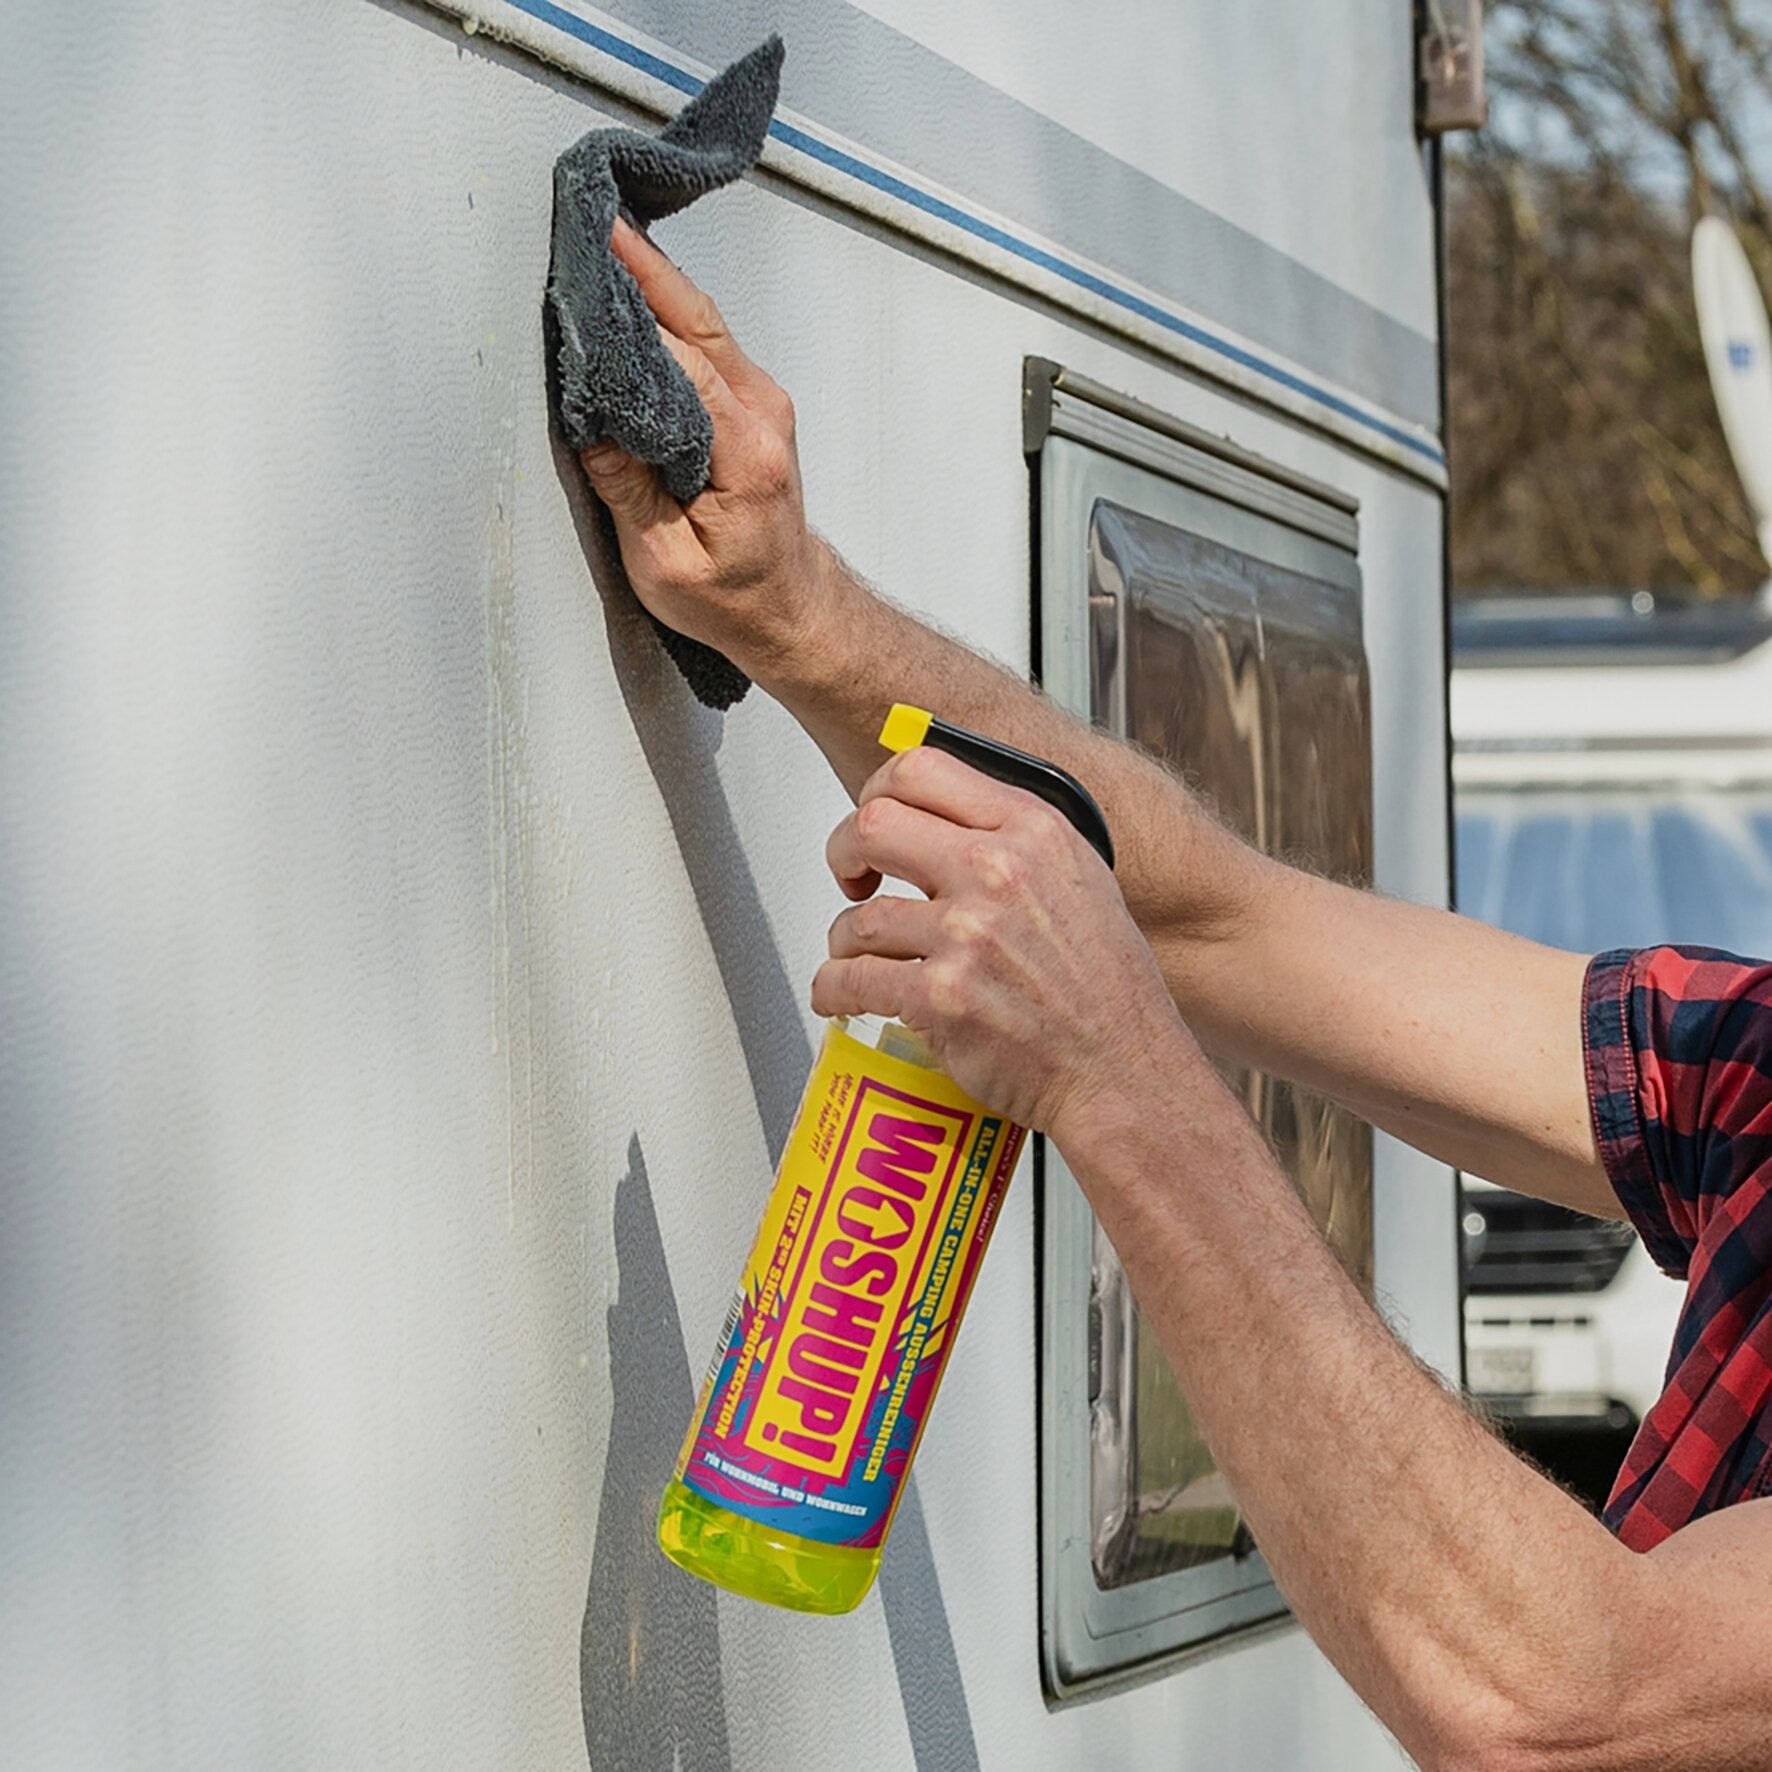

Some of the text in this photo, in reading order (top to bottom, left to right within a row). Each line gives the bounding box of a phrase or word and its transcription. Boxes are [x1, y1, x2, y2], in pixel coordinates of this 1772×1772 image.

[712, 1193, 808, 1439] MIT 2ND SKIN-PROTECTION
[861, 1125, 996, 1483] ALL-IN-ONE CAMPING AUSSENREINIGER
[703, 1450, 721, 1467] FÜR
[780, 1486, 805, 1502] UND
